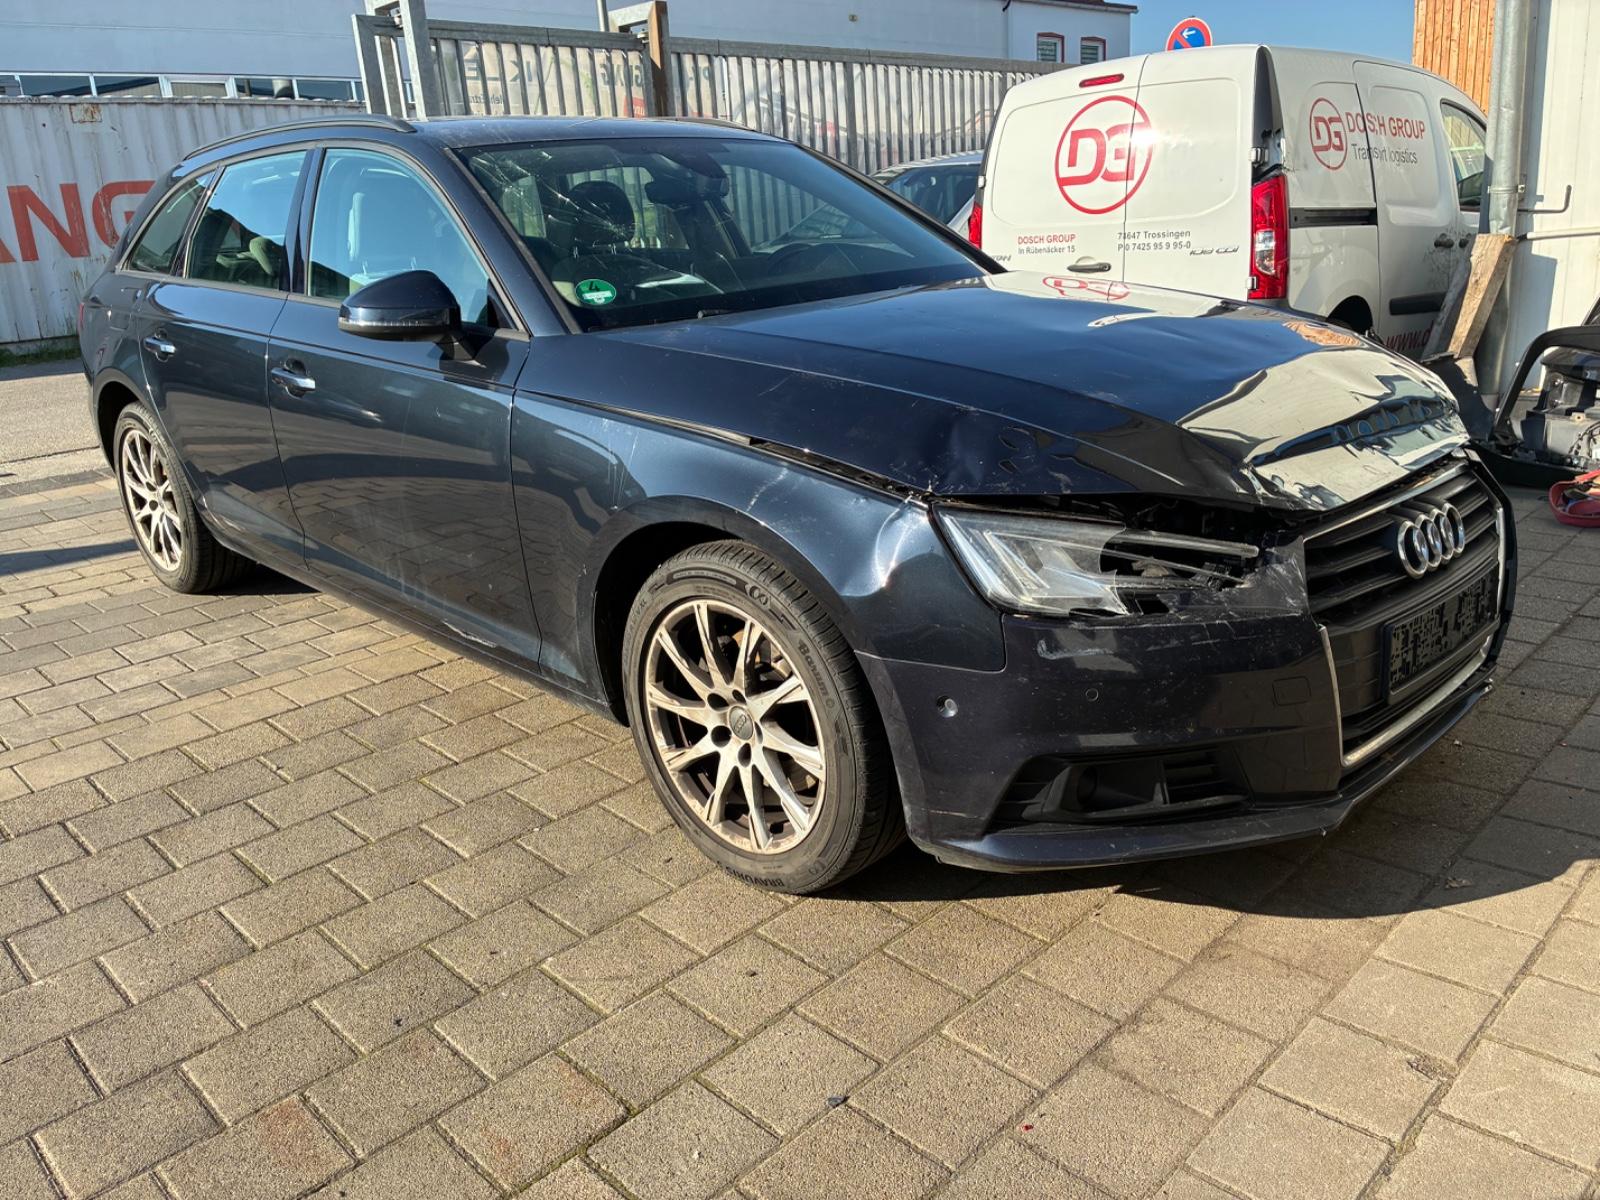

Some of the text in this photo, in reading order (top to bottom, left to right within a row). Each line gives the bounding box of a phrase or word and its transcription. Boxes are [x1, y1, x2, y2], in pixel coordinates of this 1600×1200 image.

[1388, 116, 1426, 140] GROUP
[1017, 233, 1076, 245] DOSCH GROUP
[1143, 230, 1191, 240] Trossingen
[1067, 244, 1076, 253] 15
[1132, 243, 1152, 251] 7425
[1153, 242, 1163, 250] 95
[1172, 240, 1191, 250] 95-0
[589, 281, 600, 291] 4
